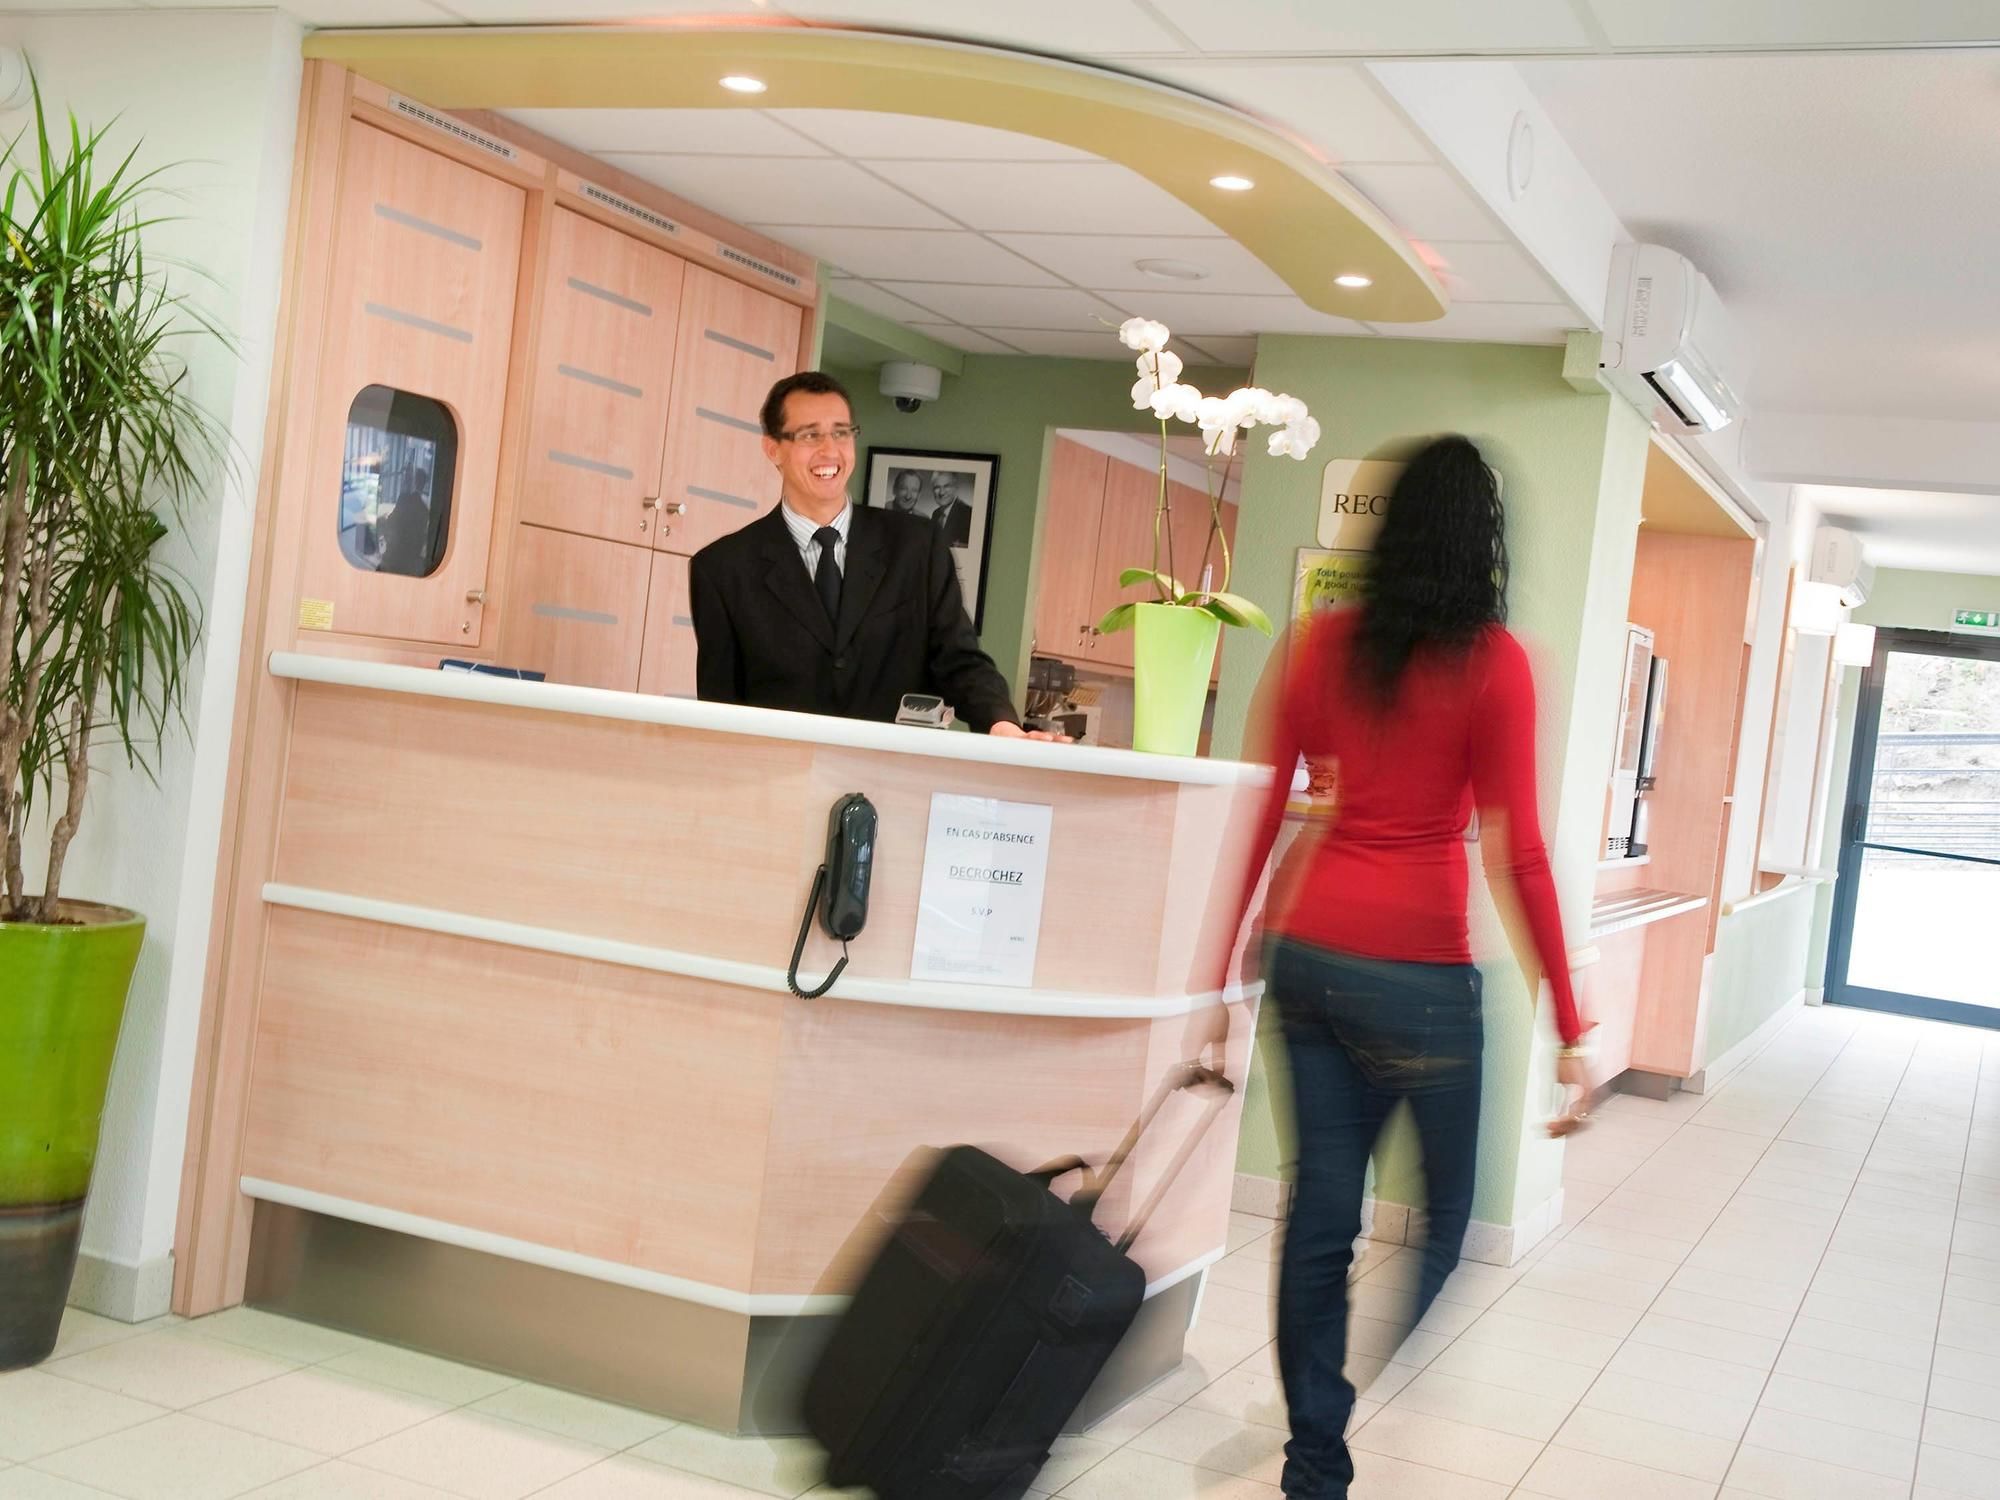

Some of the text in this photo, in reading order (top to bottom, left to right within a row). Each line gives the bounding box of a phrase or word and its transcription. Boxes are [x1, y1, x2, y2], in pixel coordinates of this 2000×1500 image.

[1333, 493, 1390, 517] REC
[1316, 567, 1337, 577] Tout
[1314, 579, 1322, 588] A
[1324, 580, 1348, 590] good
[946, 826, 1036, 845] EN CAS D'ABSENCE
[949, 865, 1024, 883] DECROCHEZ
